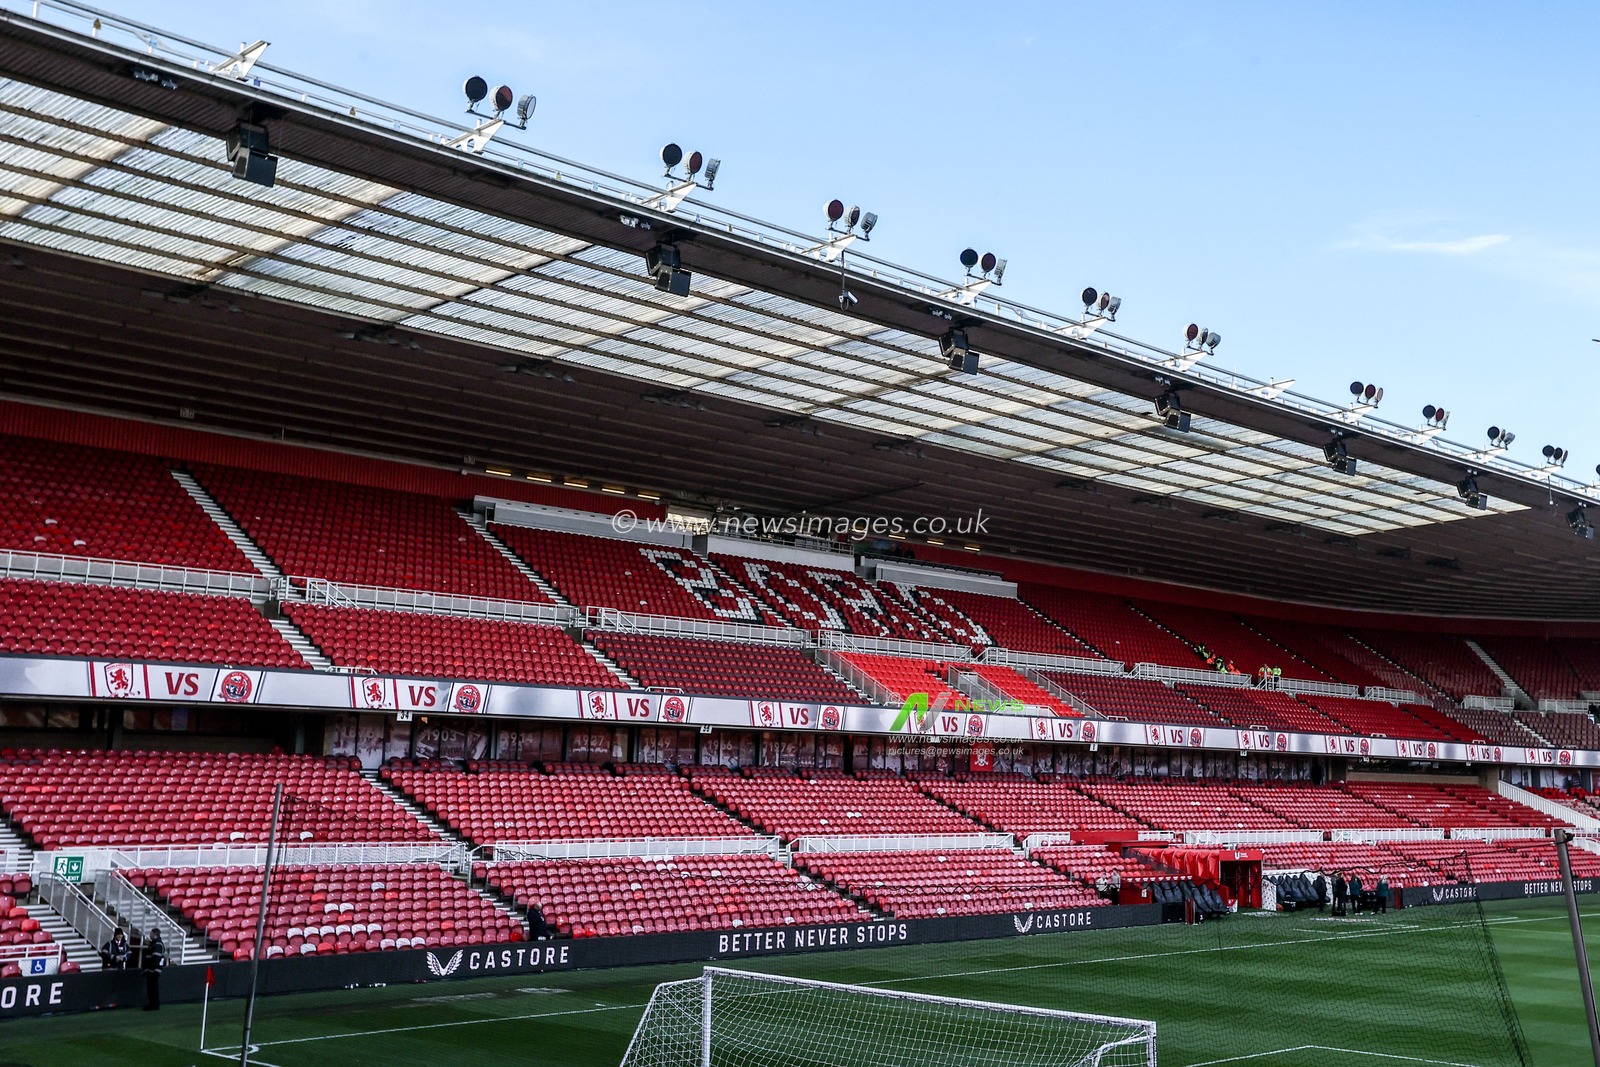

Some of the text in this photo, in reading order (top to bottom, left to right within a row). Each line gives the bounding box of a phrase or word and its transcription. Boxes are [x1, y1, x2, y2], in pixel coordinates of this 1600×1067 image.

[165, 672, 199, 696] VS
[408, 685, 436, 707] VS
[627, 698, 650, 717] VS
[789, 708, 810, 725] VS
[942, 717, 959, 732] VS
[1058, 723, 1073, 738] VS
[425, 729, 457, 741] 1903
[1170, 730, 1184, 743] VS
[1259, 735, 1271, 748] VS
[1344, 739, 1355, 752] VS
[1413, 744, 1423, 755] VS
[1481, 748, 1491, 759] VS
[1542, 752, 1553, 762] VS
[1445, 887, 1477, 899] CASTORE
[1524, 882, 1548, 894] BETTER
[1573, 880, 1592, 891] STOPS
[1036, 911, 1092, 929] CASTORE
[719, 922, 908, 953] BETTER NEVER STOPS
[469, 945, 569, 971] CASTORE
[1, 982, 64, 1009] ORE
